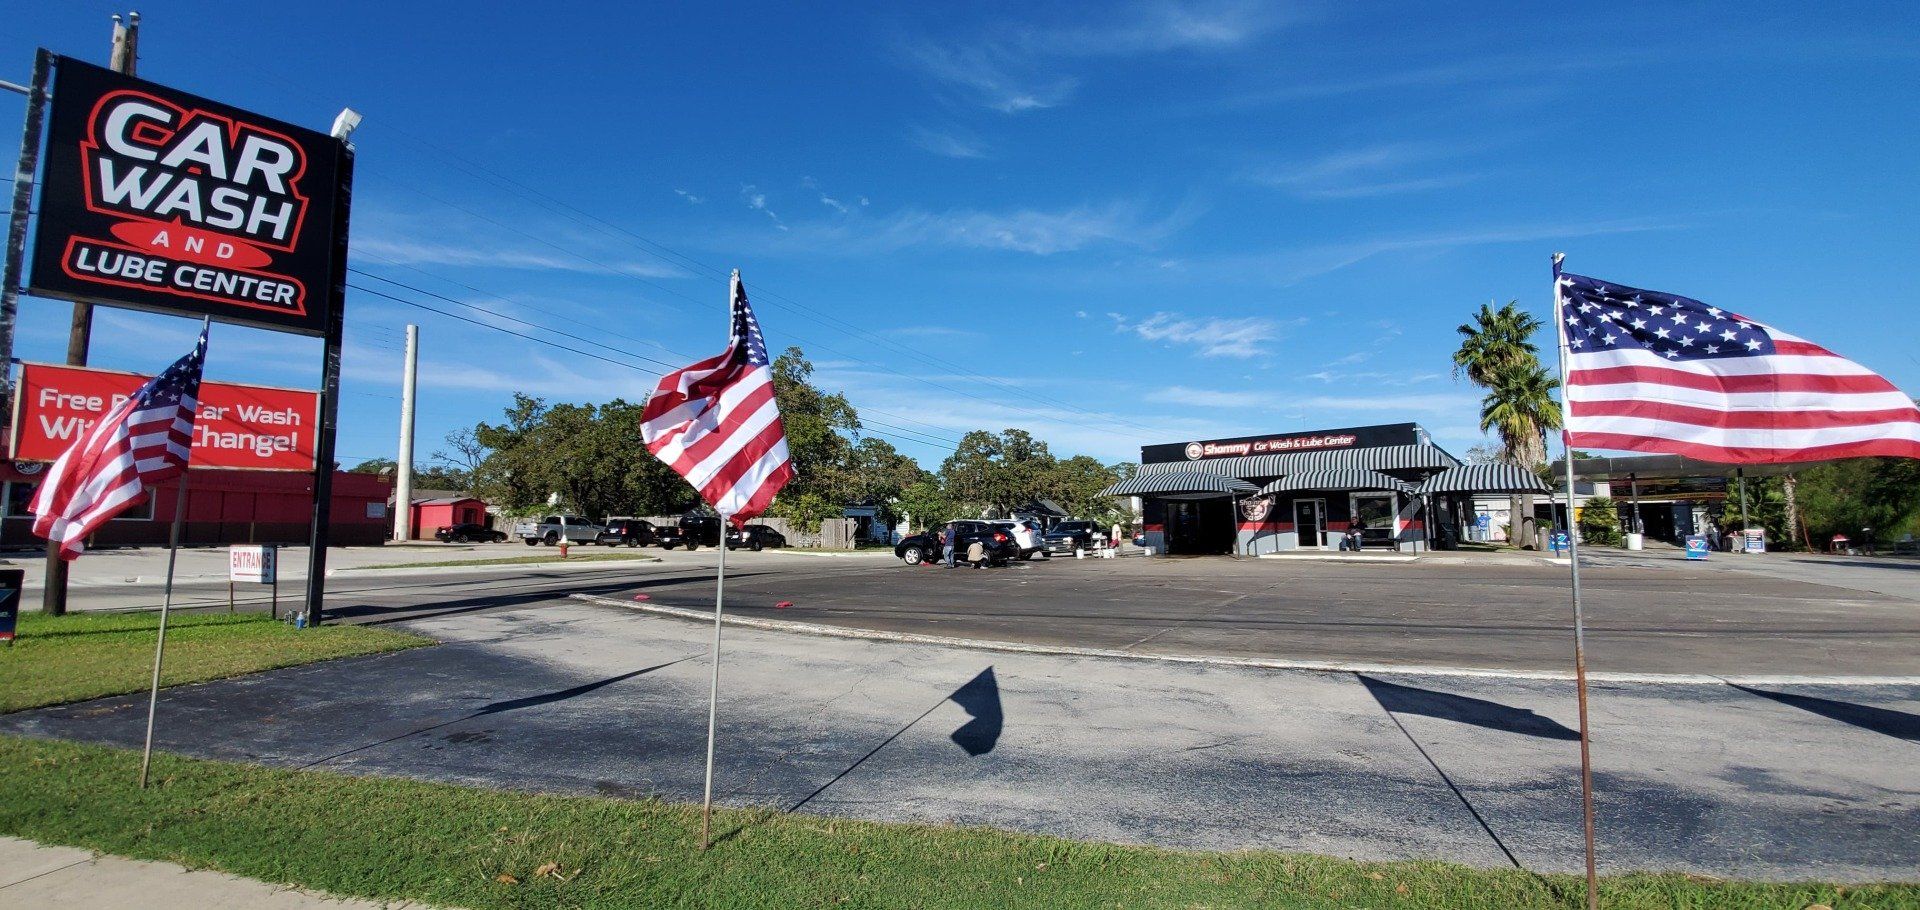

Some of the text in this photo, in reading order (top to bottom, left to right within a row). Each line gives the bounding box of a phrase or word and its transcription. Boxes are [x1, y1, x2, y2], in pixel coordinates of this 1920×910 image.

[105, 102, 294, 195] CAR
[99, 157, 293, 240] WASH
[151, 230, 234, 259] AND
[76, 248, 295, 305] LUBE CENTER
[39, 388, 103, 412] Free
[236, 404, 300, 426] Wash
[1254, 442, 1267, 451] Car
[1270, 440, 1292, 450] Wash
[1294, 438, 1300, 447] &
[1302, 437, 1323, 447] Lube
[1324, 436, 1354, 446] Center
[232, 551, 271, 569] ENTRANCE
